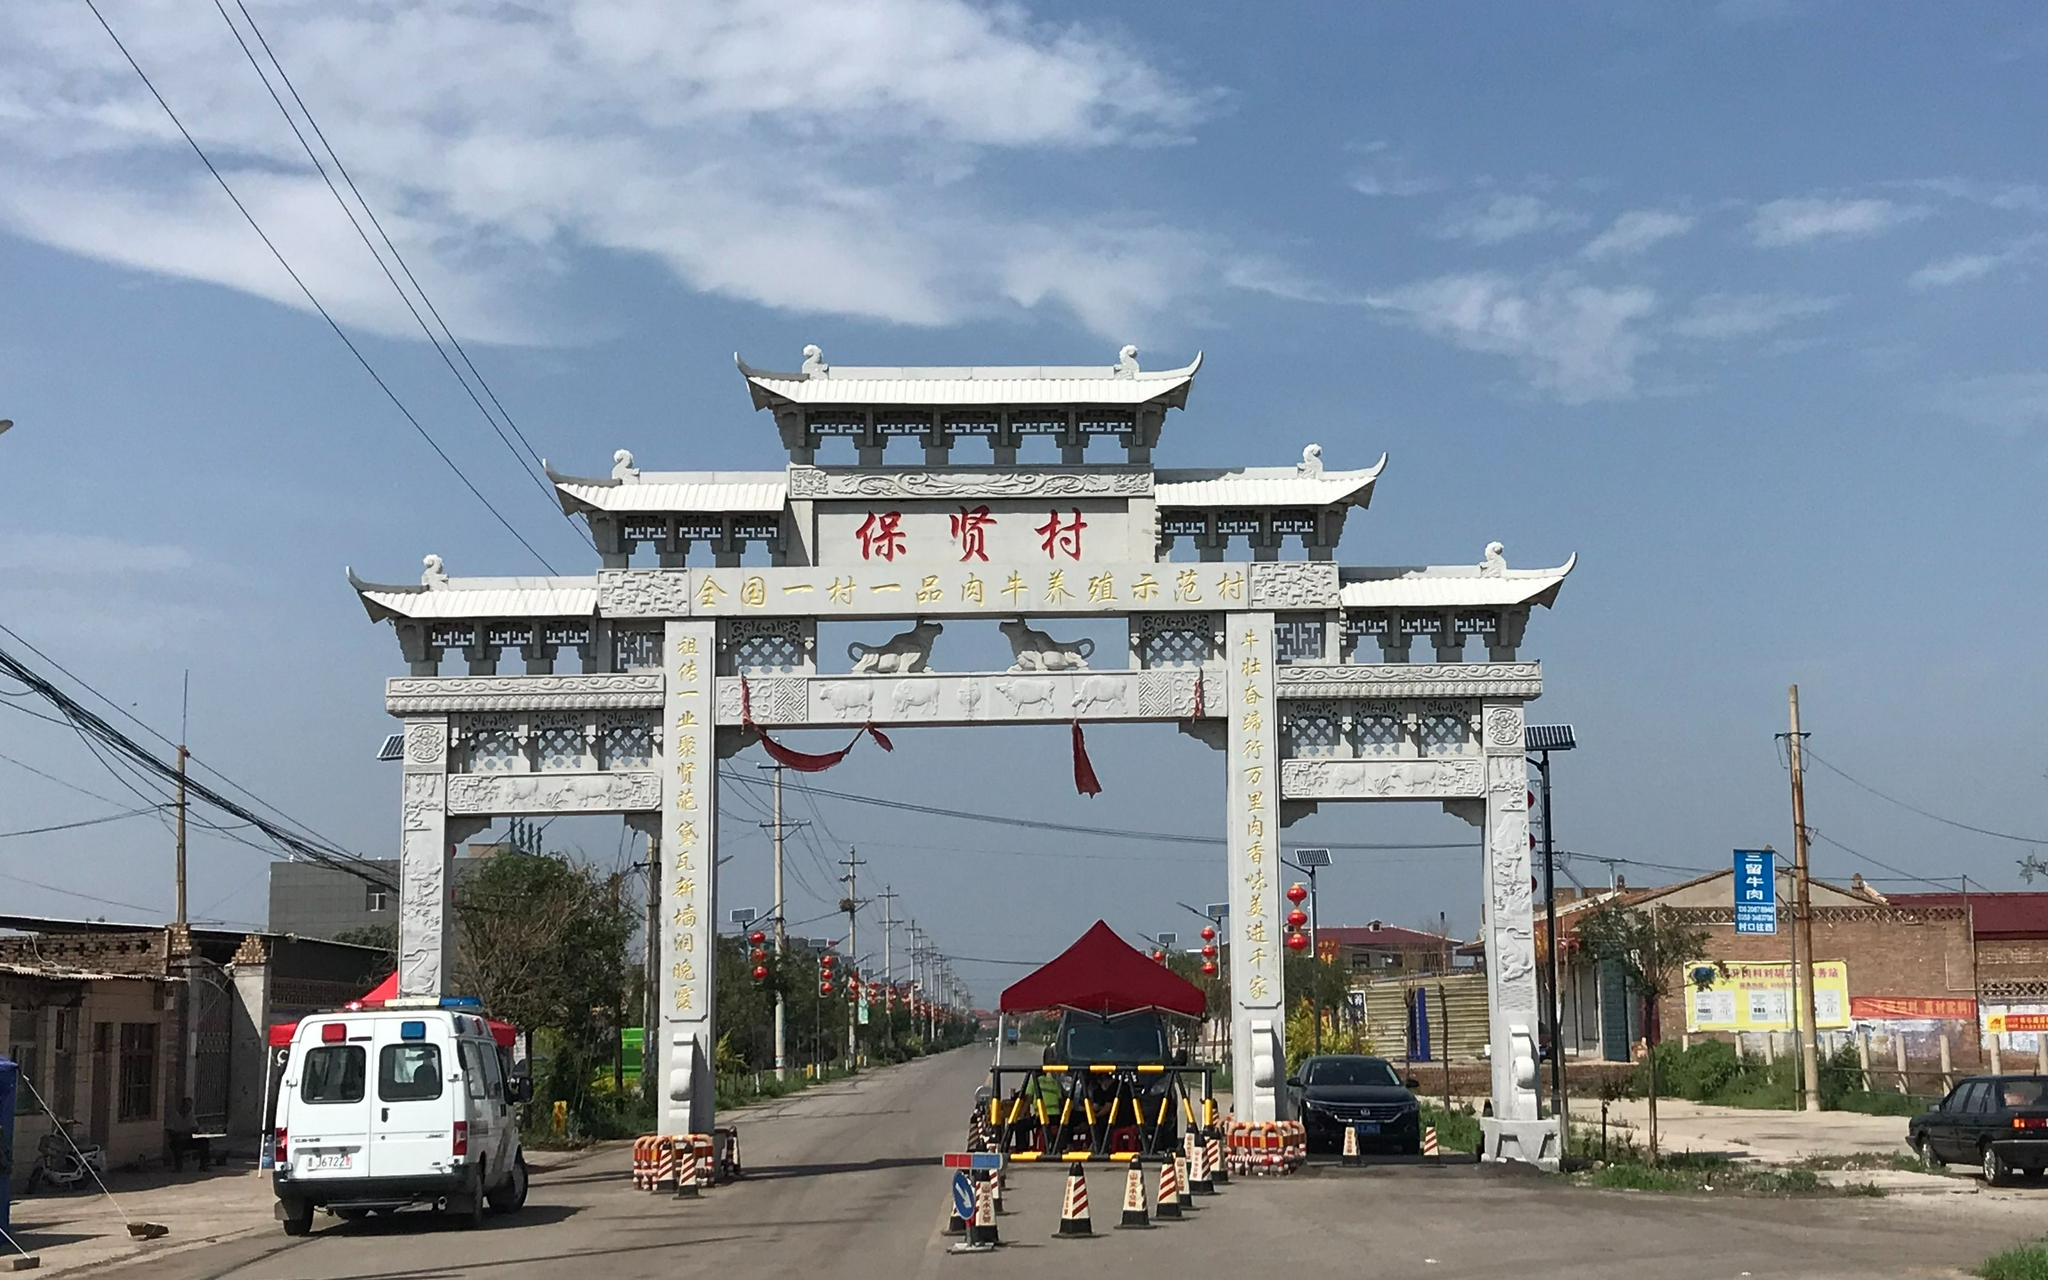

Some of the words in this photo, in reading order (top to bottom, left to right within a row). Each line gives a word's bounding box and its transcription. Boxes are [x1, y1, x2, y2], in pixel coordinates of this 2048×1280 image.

[856, 504, 1088, 562] 保贤村
[694, 568, 1245, 608] 全国一村一品肉牛养殖示范村
